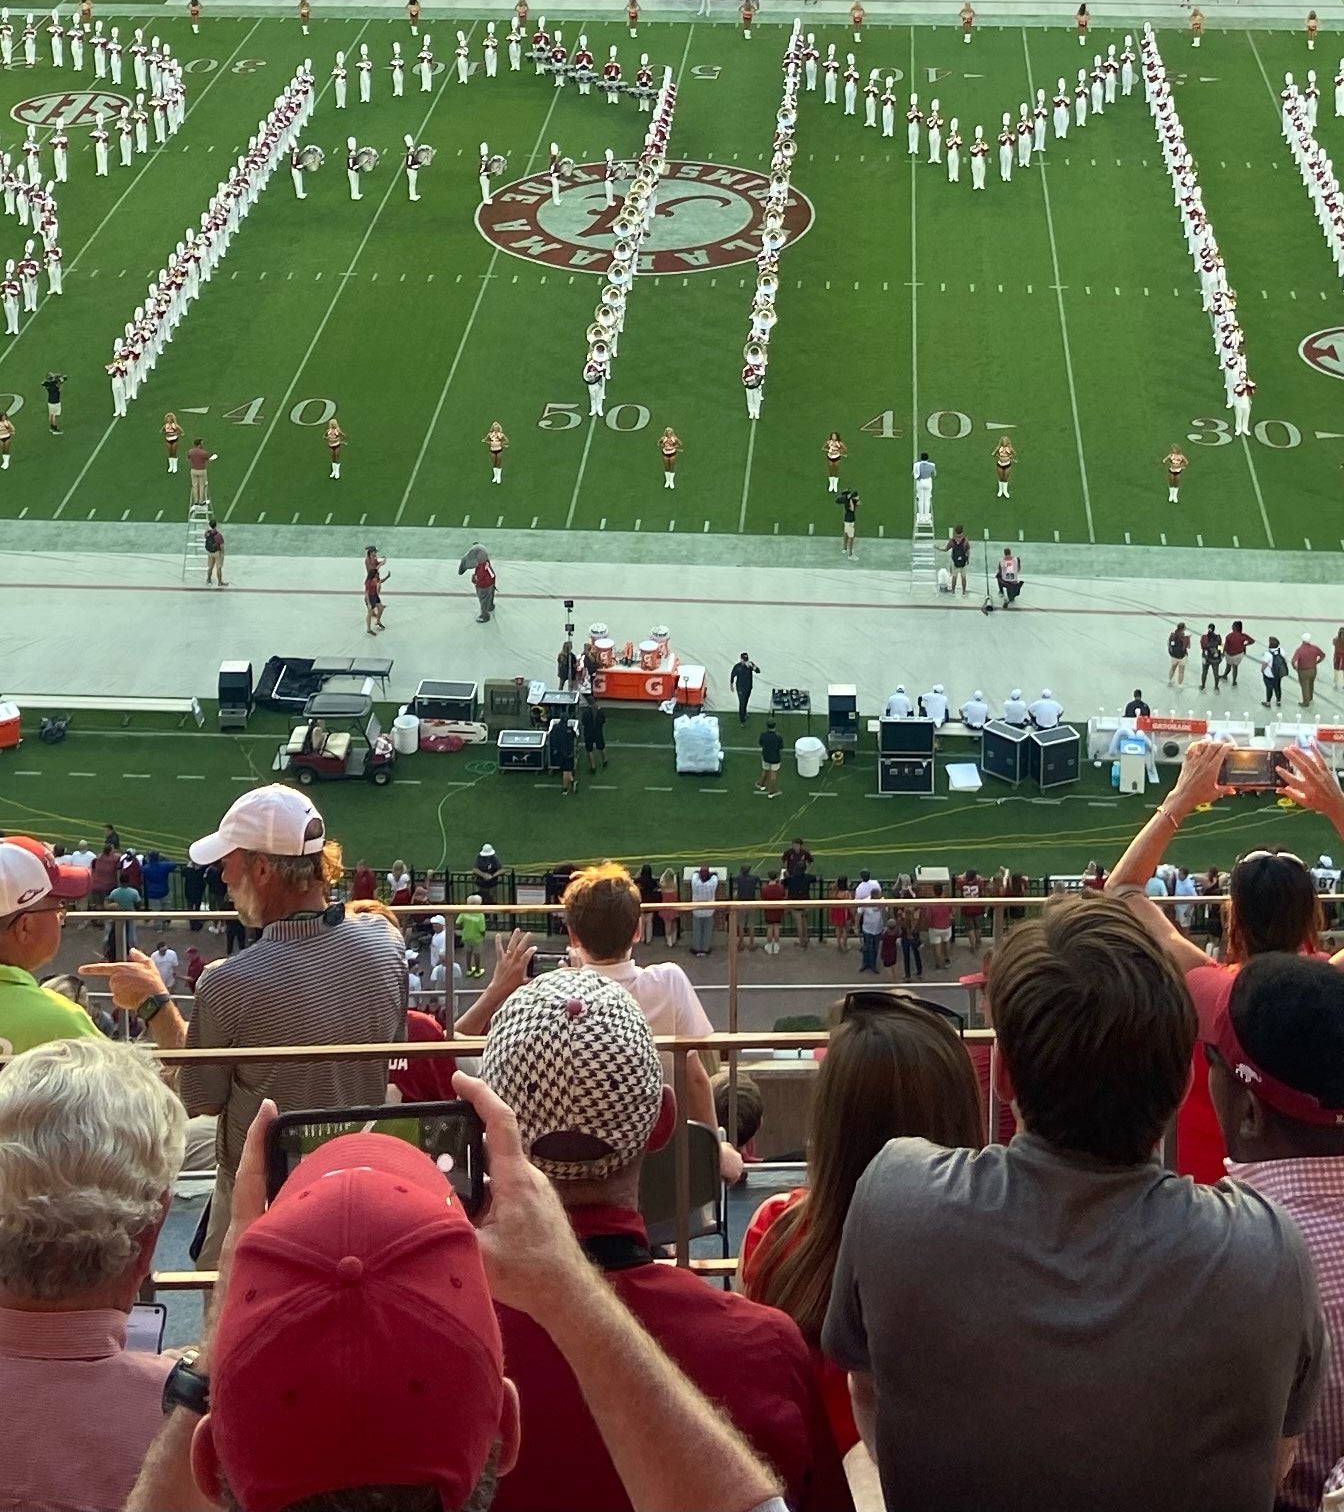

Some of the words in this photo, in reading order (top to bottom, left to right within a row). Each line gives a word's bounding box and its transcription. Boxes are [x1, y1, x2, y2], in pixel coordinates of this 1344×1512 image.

[221, 396, 338, 426] 40
[536, 402, 652, 432] 50
[858, 409, 974, 440] 40
[1186, 417, 1304, 450] 30
